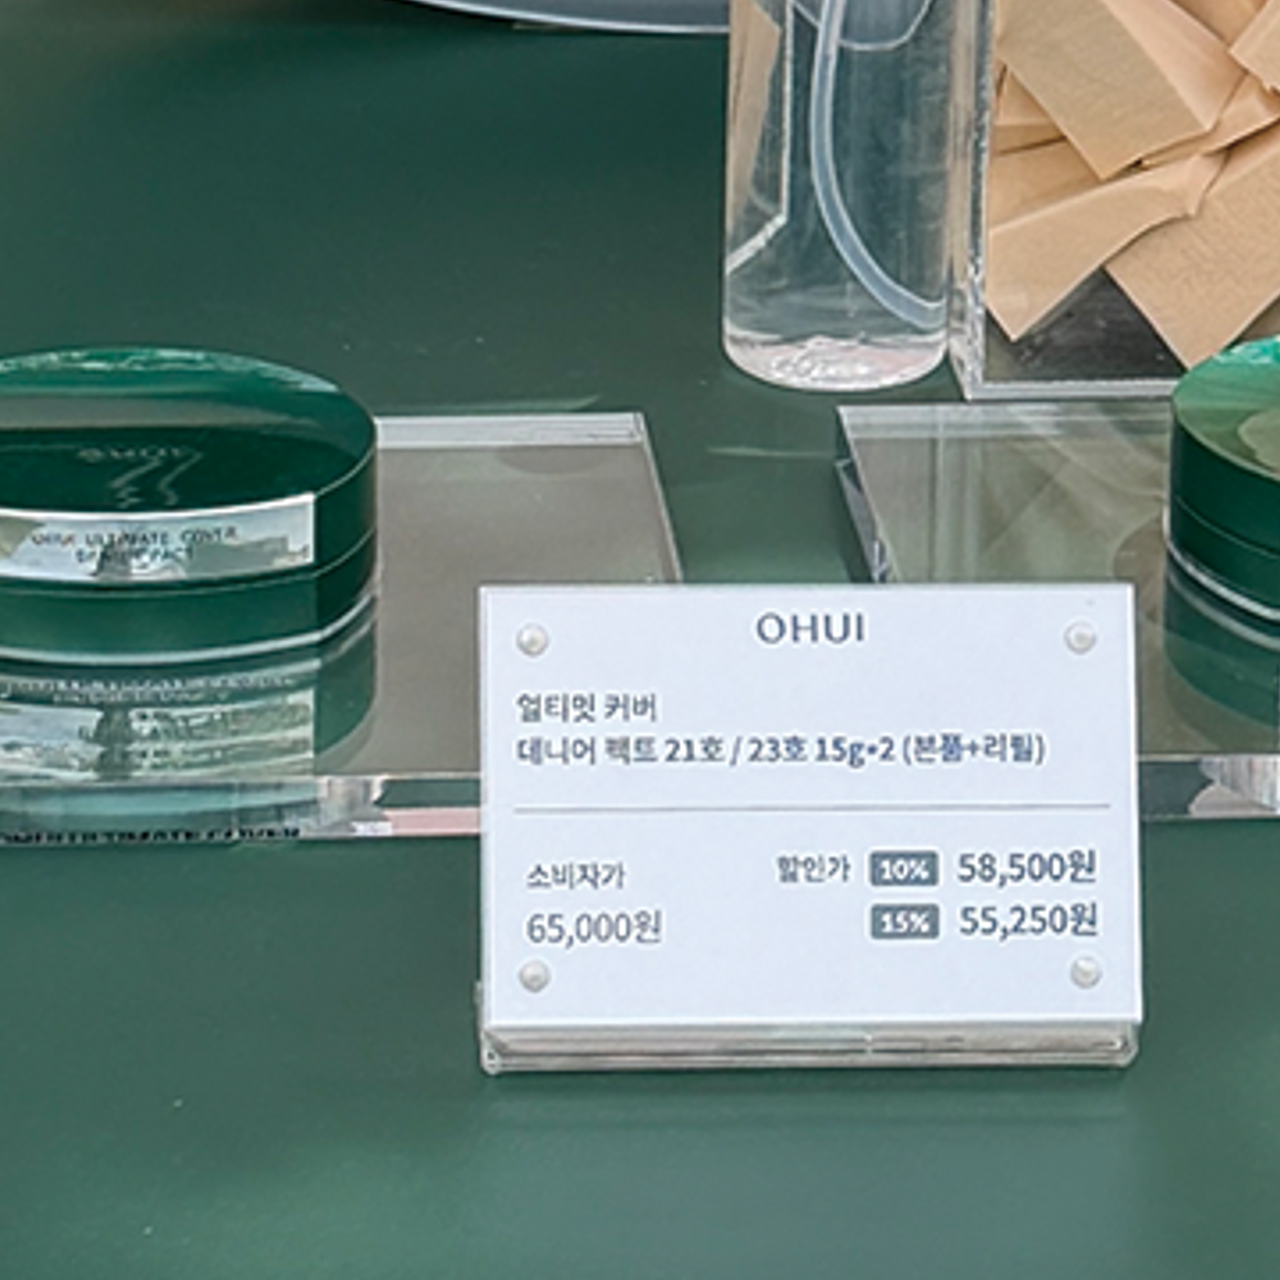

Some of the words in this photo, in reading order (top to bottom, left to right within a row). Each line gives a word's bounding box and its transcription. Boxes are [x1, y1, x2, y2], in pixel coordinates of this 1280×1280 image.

[756, 611, 865, 644] OHUI
[516, 692, 596, 723] 얼티밋
[604, 692, 657, 723] 커버
[516, 736, 596, 766] 데니어
[665, 736, 724, 763] 21호
[729, 735, 742, 767] /
[748, 735, 807, 763] 23호
[526, 862, 626, 891] 소비자가
[777, 854, 852, 883] 할인가
[879, 859, 930, 881] 10%
[957, 848, 1097, 889] 58,500원
[526, 909, 662, 950] 65,000원
[880, 912, 931, 934] 15%
[959, 901, 1099, 943] 55,250원
